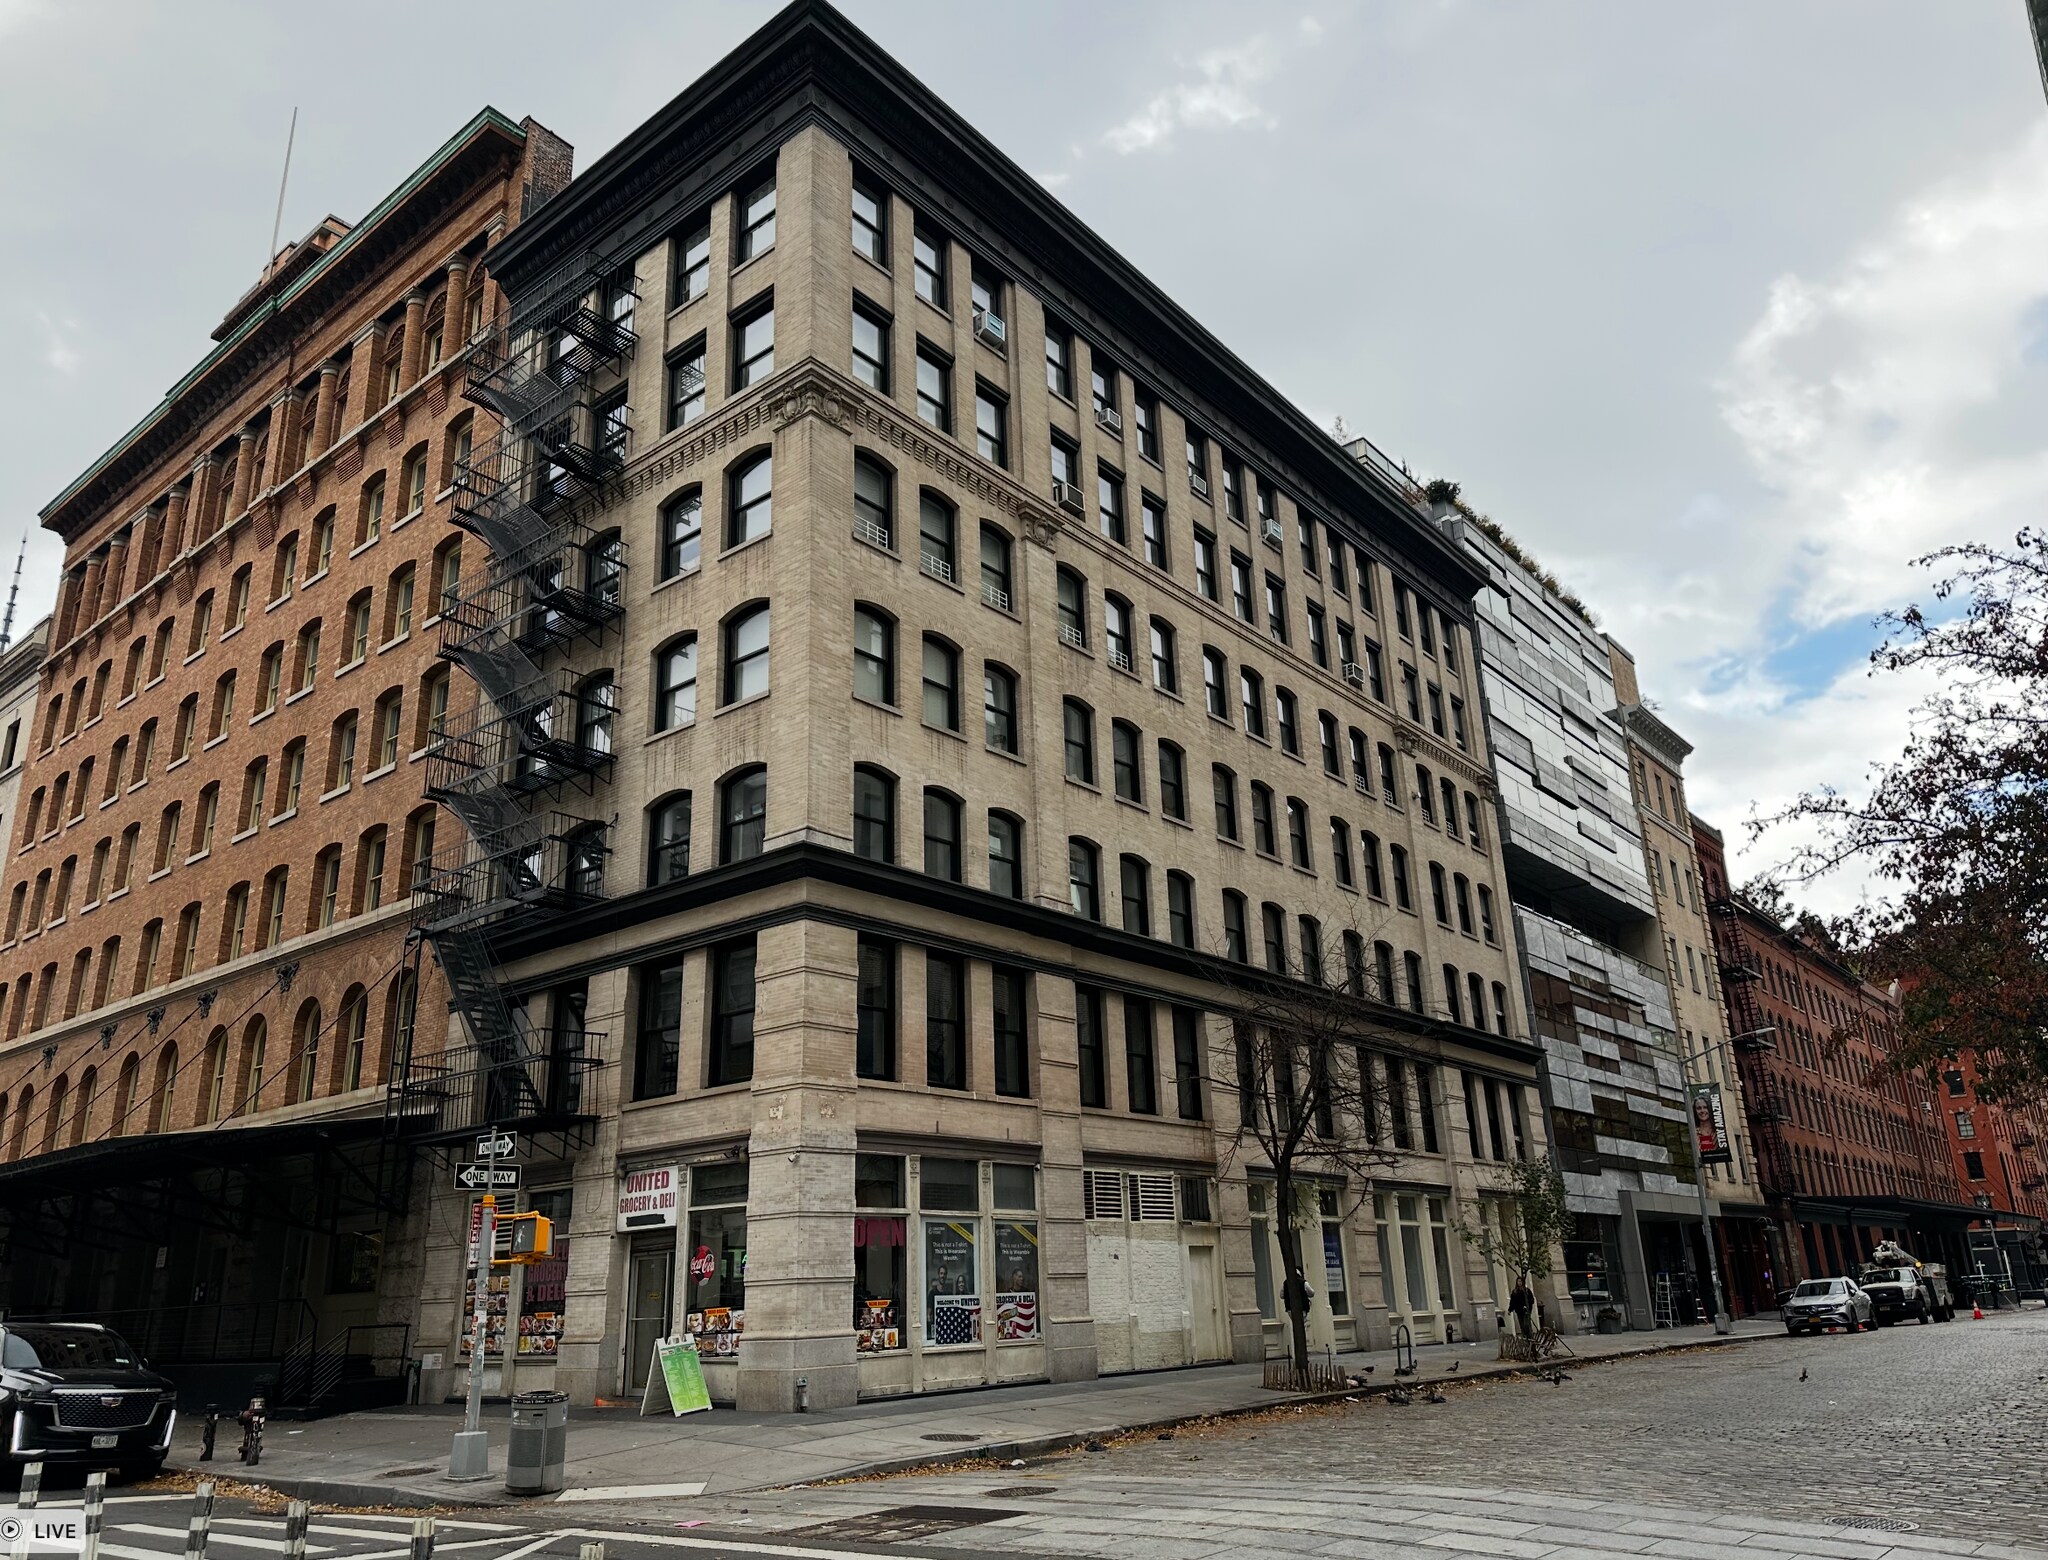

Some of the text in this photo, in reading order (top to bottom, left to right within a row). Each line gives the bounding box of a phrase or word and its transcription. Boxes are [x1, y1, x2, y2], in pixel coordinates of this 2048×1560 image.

[1710, 1094, 1727, 1148] STAY AMAZING
[498, 1141, 510, 1151] WAY
[465, 1171, 513, 1183] ONE WAY
[626, 1170, 670, 1194] UNITED
[619, 1191, 676, 1214] GROCERY & DELI
[854, 1217, 904, 1248] OPEN
[526, 1285, 535, 1303] &
[961, 1298, 980, 1306] UNITED
[1023, 1295, 1034, 1303] DELI
